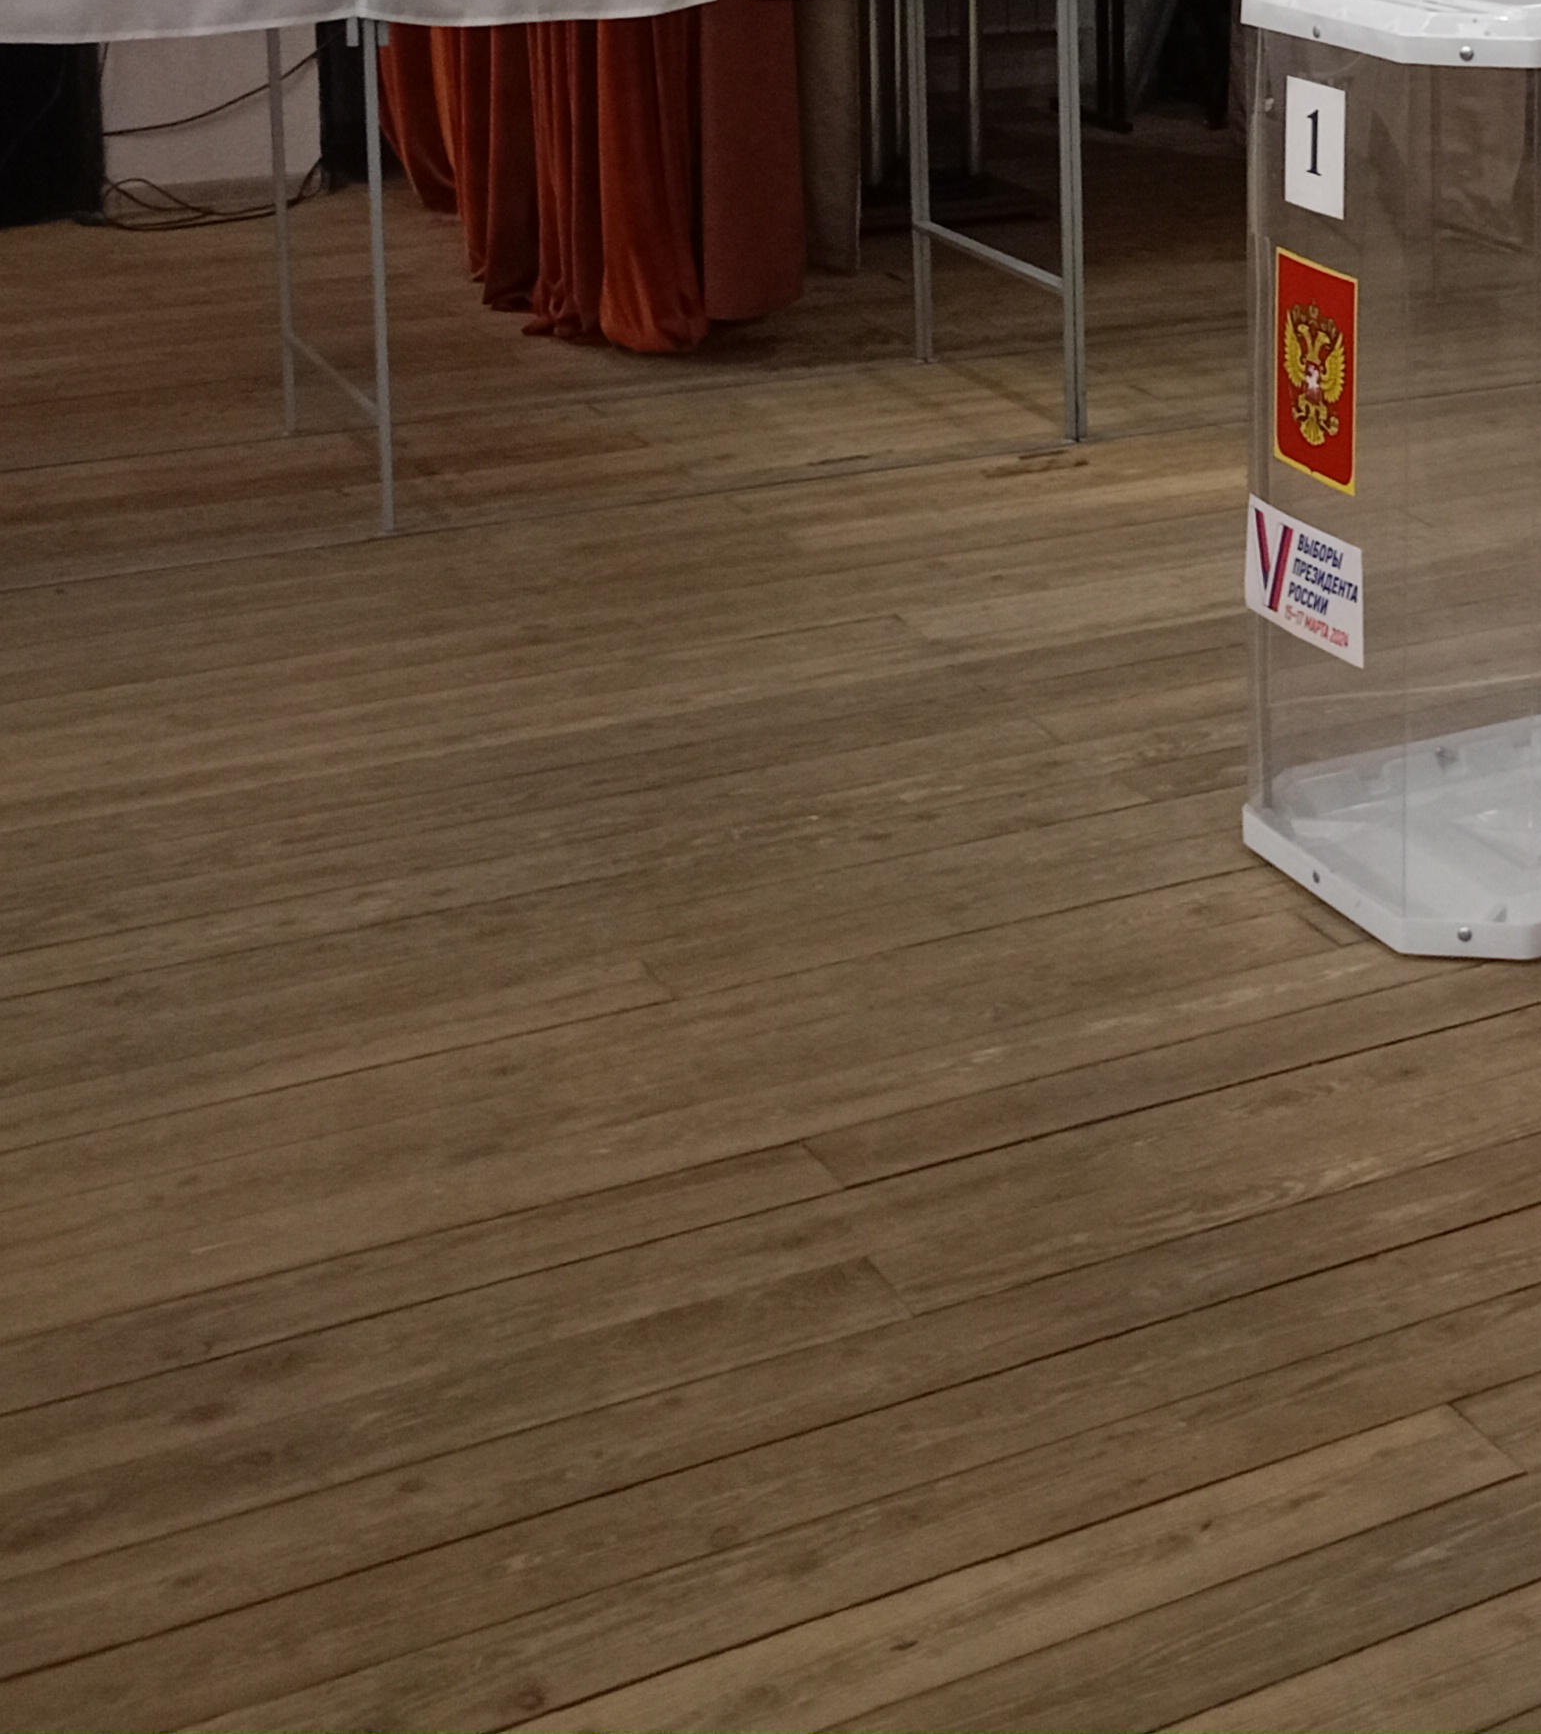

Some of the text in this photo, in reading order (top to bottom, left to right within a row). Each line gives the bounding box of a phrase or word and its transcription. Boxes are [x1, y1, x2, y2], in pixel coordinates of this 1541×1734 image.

[1306, 109, 1322, 176] 1
[1297, 533, 1344, 570] ВЫБОРЫ
[1287, 581, 1329, 616] РОССИИ
[1292, 558, 1359, 603] ПРЕЗИДЕНТА
